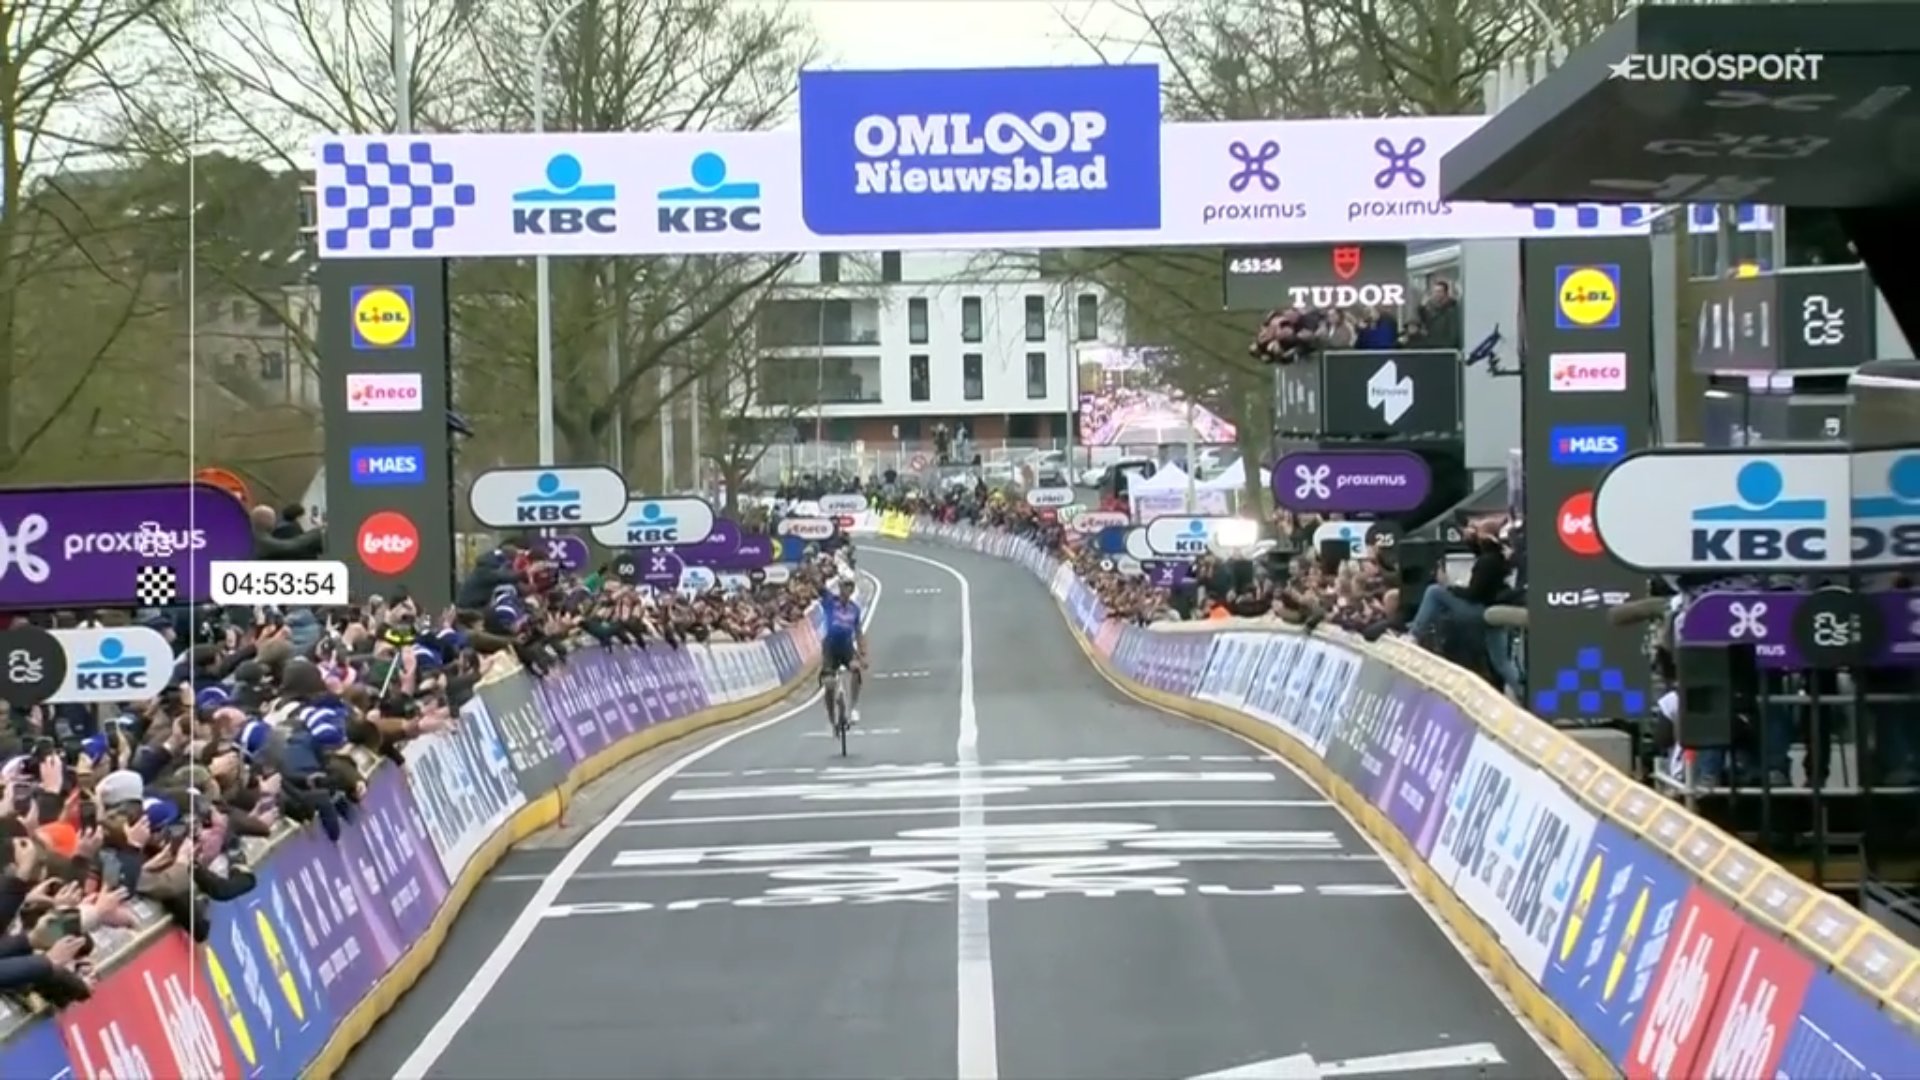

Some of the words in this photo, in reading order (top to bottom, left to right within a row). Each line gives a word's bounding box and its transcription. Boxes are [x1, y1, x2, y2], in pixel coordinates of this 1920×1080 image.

[854, 111, 1107, 158] OMLOOP
[855, 154, 1107, 195] Nieuwsblad
[657, 206, 760, 232] KBC
[1203, 202, 1307, 224] proximus
[1348, 199, 1452, 222] proximus
[513, 207, 616, 234] KBC
[1229, 257, 1283, 274] 4:53:54
[1288, 284, 1405, 309] TUDOR
[1567, 365, 1620, 379] Eneco
[365, 385, 417, 399] Eneco
[1570, 436, 1619, 453] MAES
[369, 457, 417, 473] MAES
[1336, 473, 1407, 489] proximus
[517, 505, 580, 521] KBC
[1562, 513, 1593, 533] lot
[363, 532, 413, 554] lotto
[627, 528, 677, 543] KBC
[1375, 533, 1394, 546] 25
[1692, 527, 1826, 561] KBC
[1547, 592, 1579, 605] UCI
[76, 671, 147, 690] KBC
